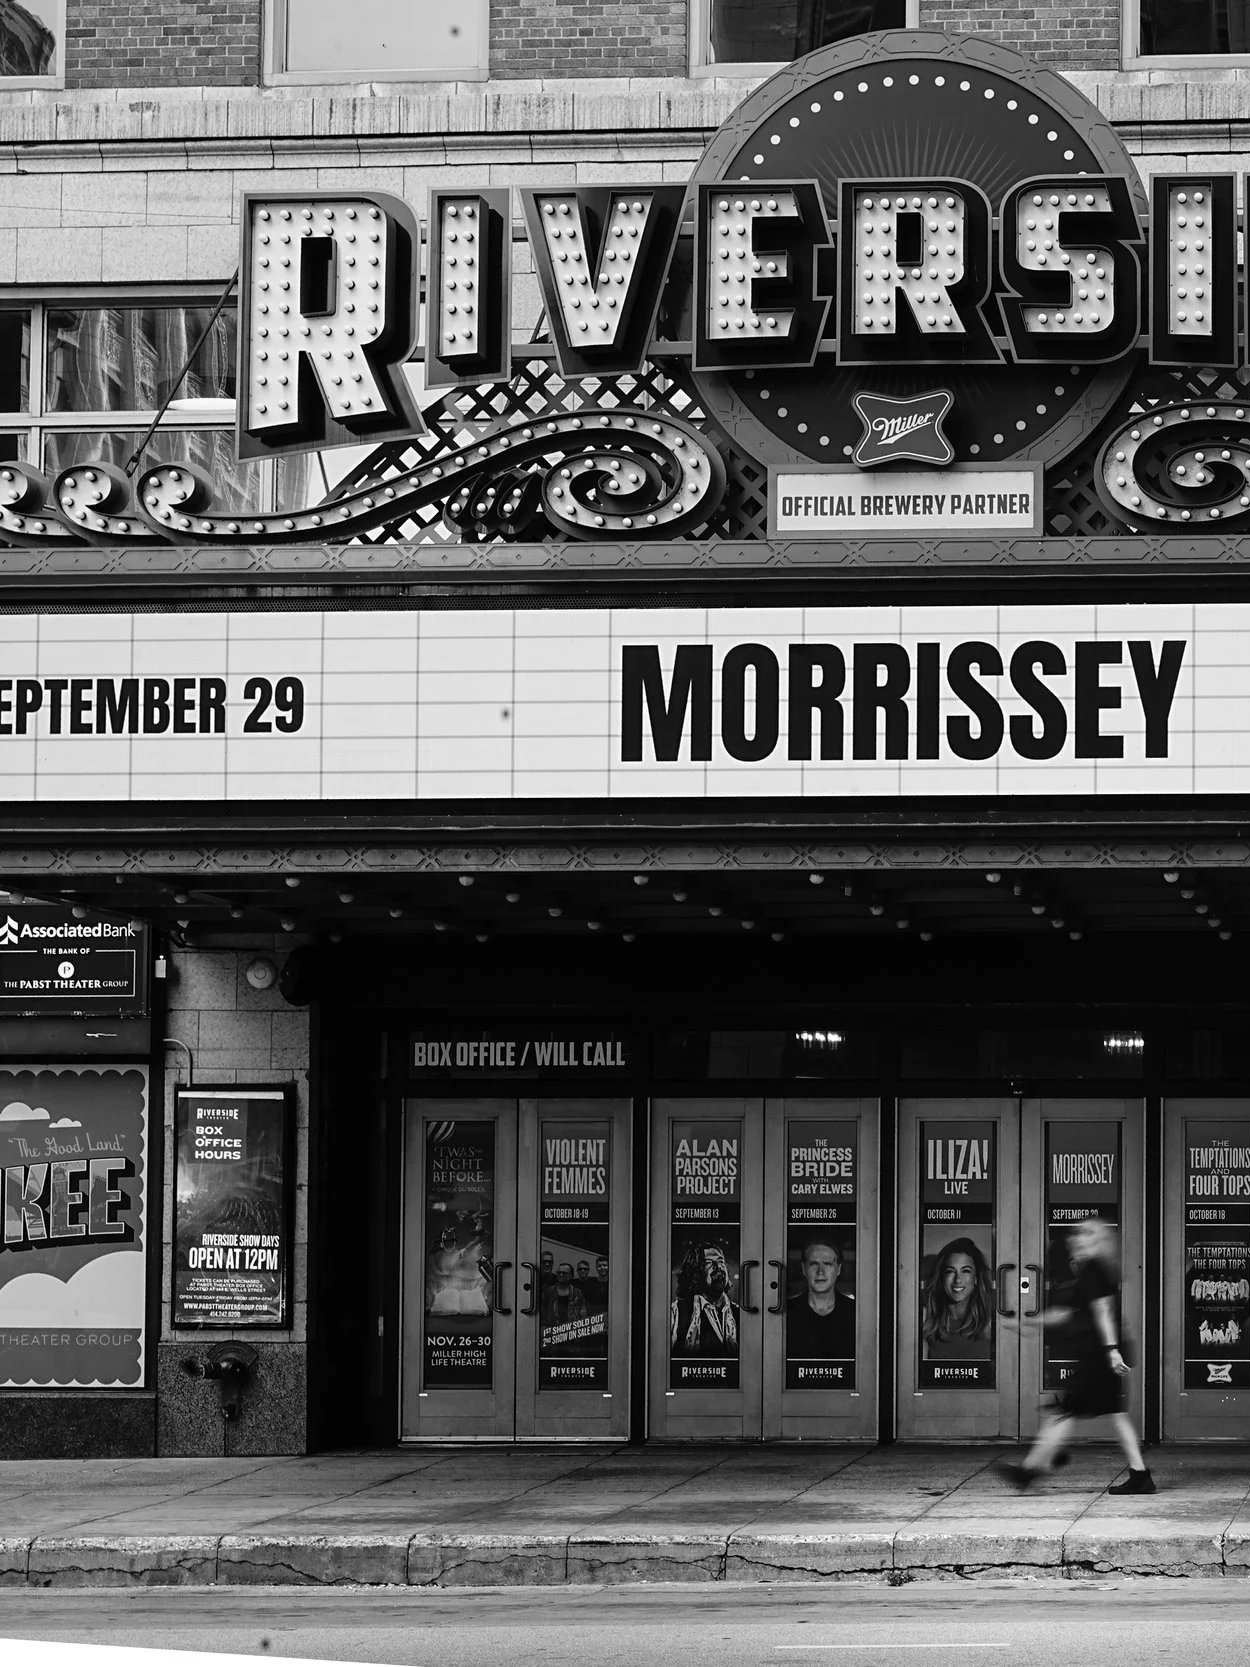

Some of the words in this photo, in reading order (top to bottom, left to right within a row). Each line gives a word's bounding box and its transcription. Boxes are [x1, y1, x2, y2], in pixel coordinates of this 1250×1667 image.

[872, 412, 935, 445] Miller
[782, 496, 855, 516] OFFICIAL
[860, 495, 946, 516] BREWERY
[951, 493, 1030, 515] PARTNER
[243, 676, 304, 734] 29
[621, 640, 1187, 762] MORRISSEY
[20, 980, 51, 988] PABST
[53, 980, 101, 989] THEATER
[103, 980, 129, 988] GROUP
[414, 1042, 452, 1066] BOX
[456, 1042, 516, 1066] OFFICE
[520, 1042, 531, 1066] /
[534, 1042, 578, 1066] WILL
[583, 1042, 625, 1066] CALL
[197, 1108, 239, 1119] RIVERSIDE
[196, 1126, 223, 1135] BOX
[195, 1138, 242, 1148] OFFICE
[676, 1139, 738, 1157] ALAN
[815, 1139, 828, 1147] THE
[195, 1151, 241, 1160] HOURS
[546, 1139, 606, 1165] VIOLENT
[791, 1148, 853, 1161] PRINCESS
[1190, 1148, 1250, 1168] TEMPTATIONS
[433, 1156, 485, 1170] NIGHT
[928, 1140, 988, 1180] ILIZA!
[676, 1158, 737, 1176] PARSONS
[791, 1162, 853, 1177] BRIDE
[1052, 1154, 1115, 1184] MORRISSEY
[544, 1167, 606, 1195] FEMMES
[677, 1176, 737, 1195] PROJECT
[1190, 1175, 1219, 1195] FOUR
[1222, 1175, 1250, 1196] TOPS
[792, 1184, 818, 1195] CARY
[820, 1184, 853, 1195] ELWES
[944, 1182, 968, 1195] LIVE
[544, 1208, 573, 1219] OCTOBER
[573, 1208, 589, 1219] 18-19
[675, 1208, 712, 1218] SEPTEMBER
[713, 1208, 719, 1218] 13
[792, 1208, 828, 1219] SEPTEMBER
[829, 1208, 837, 1219] 26
[928, 1209, 955, 1219] OCTOBER
[1190, 1210, 1217, 1220] OCTOBER
[1218, 1210, 1226, 1220] 18
[202, 1234, 239, 1247] RIVERSIDE
[240, 1234, 261, 1247] SHOW
[262, 1236, 280, 1247] DAYS
[189, 1247, 224, 1269] OPEN
[226, 1248, 242, 1269] AT
[245, 1248, 278, 1270] 12PM
[1187, 1247, 1201, 1258] THE
[1194, 1259, 1206, 1269] THE
[1209, 1259, 1227, 1269] FOUR
[1228, 1259, 1246, 1269] TOPS
[552, 1322, 572, 1335] SHOW
[572, 1318, 590, 1330] SOLD
[590, 1314, 604, 1325] OUT
[568, 1330, 577, 1340] ON
[577, 1326, 590, 1338] SALE
[0, 1334, 70, 1346] THEATER
[76, 1334, 134, 1346] GROUP
[427, 1336, 457, 1346] NOV.
[432, 1350, 463, 1358] MILLER
[464, 1350, 486, 1358] HIGH
[550, 1366, 595, 1378] RIVERSIDE
[681, 1366, 727, 1378] RIVERSIDE
[798, 1367, 843, 1379] RIVERSIDE
[934, 1367, 979, 1379] RIVERSIDE
